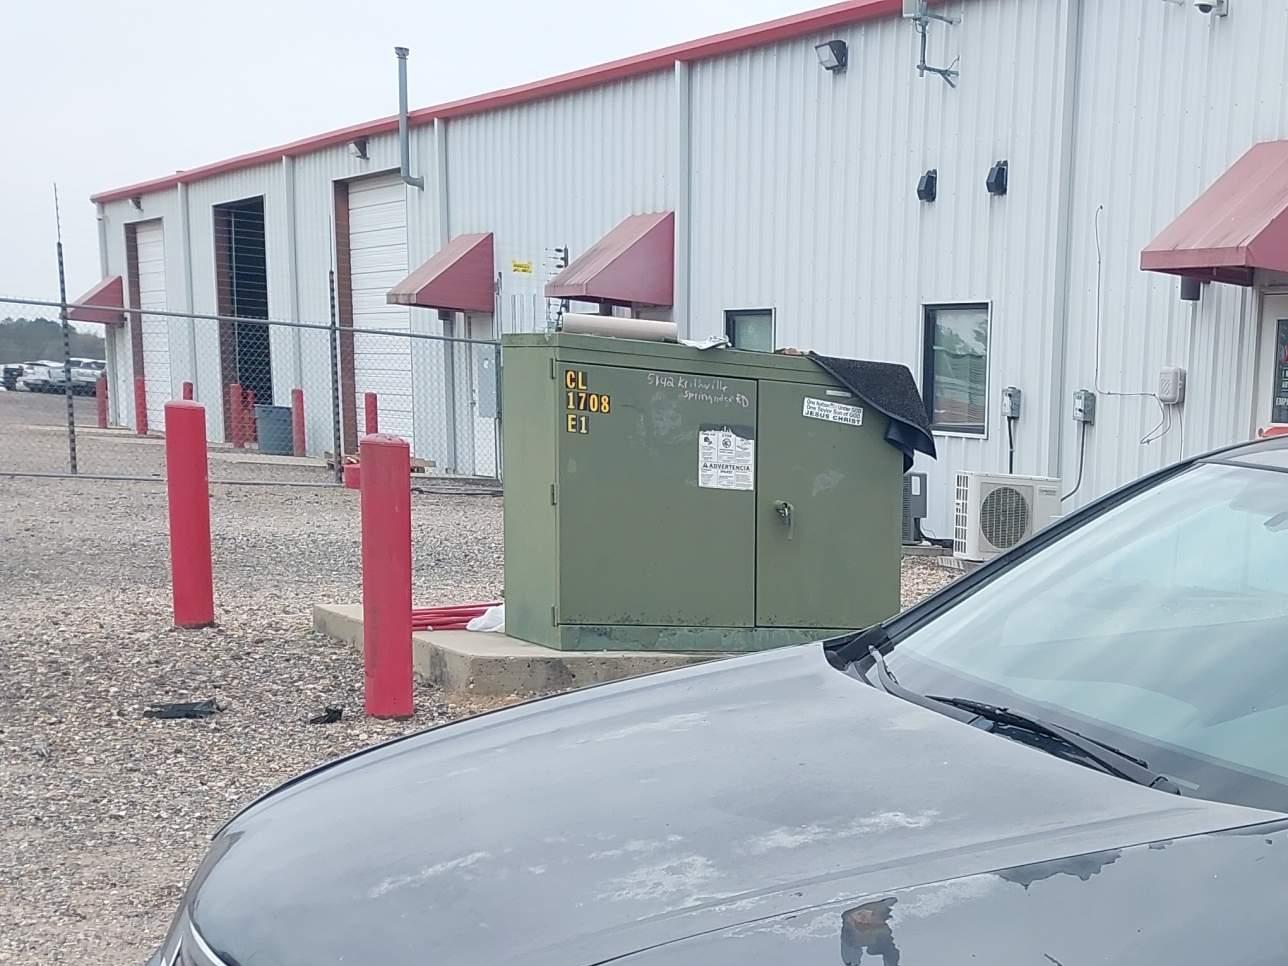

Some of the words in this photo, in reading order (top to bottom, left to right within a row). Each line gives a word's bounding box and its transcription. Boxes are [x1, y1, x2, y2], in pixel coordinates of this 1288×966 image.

[566, 370, 587, 389] CL
[567, 391, 609, 413] 1708
[567, 414, 588, 433] E1
[805, 410, 829, 419] JESUS
[833, 416, 861, 424] CHRIST
[709, 463, 751, 471] ADVERTENCIA
